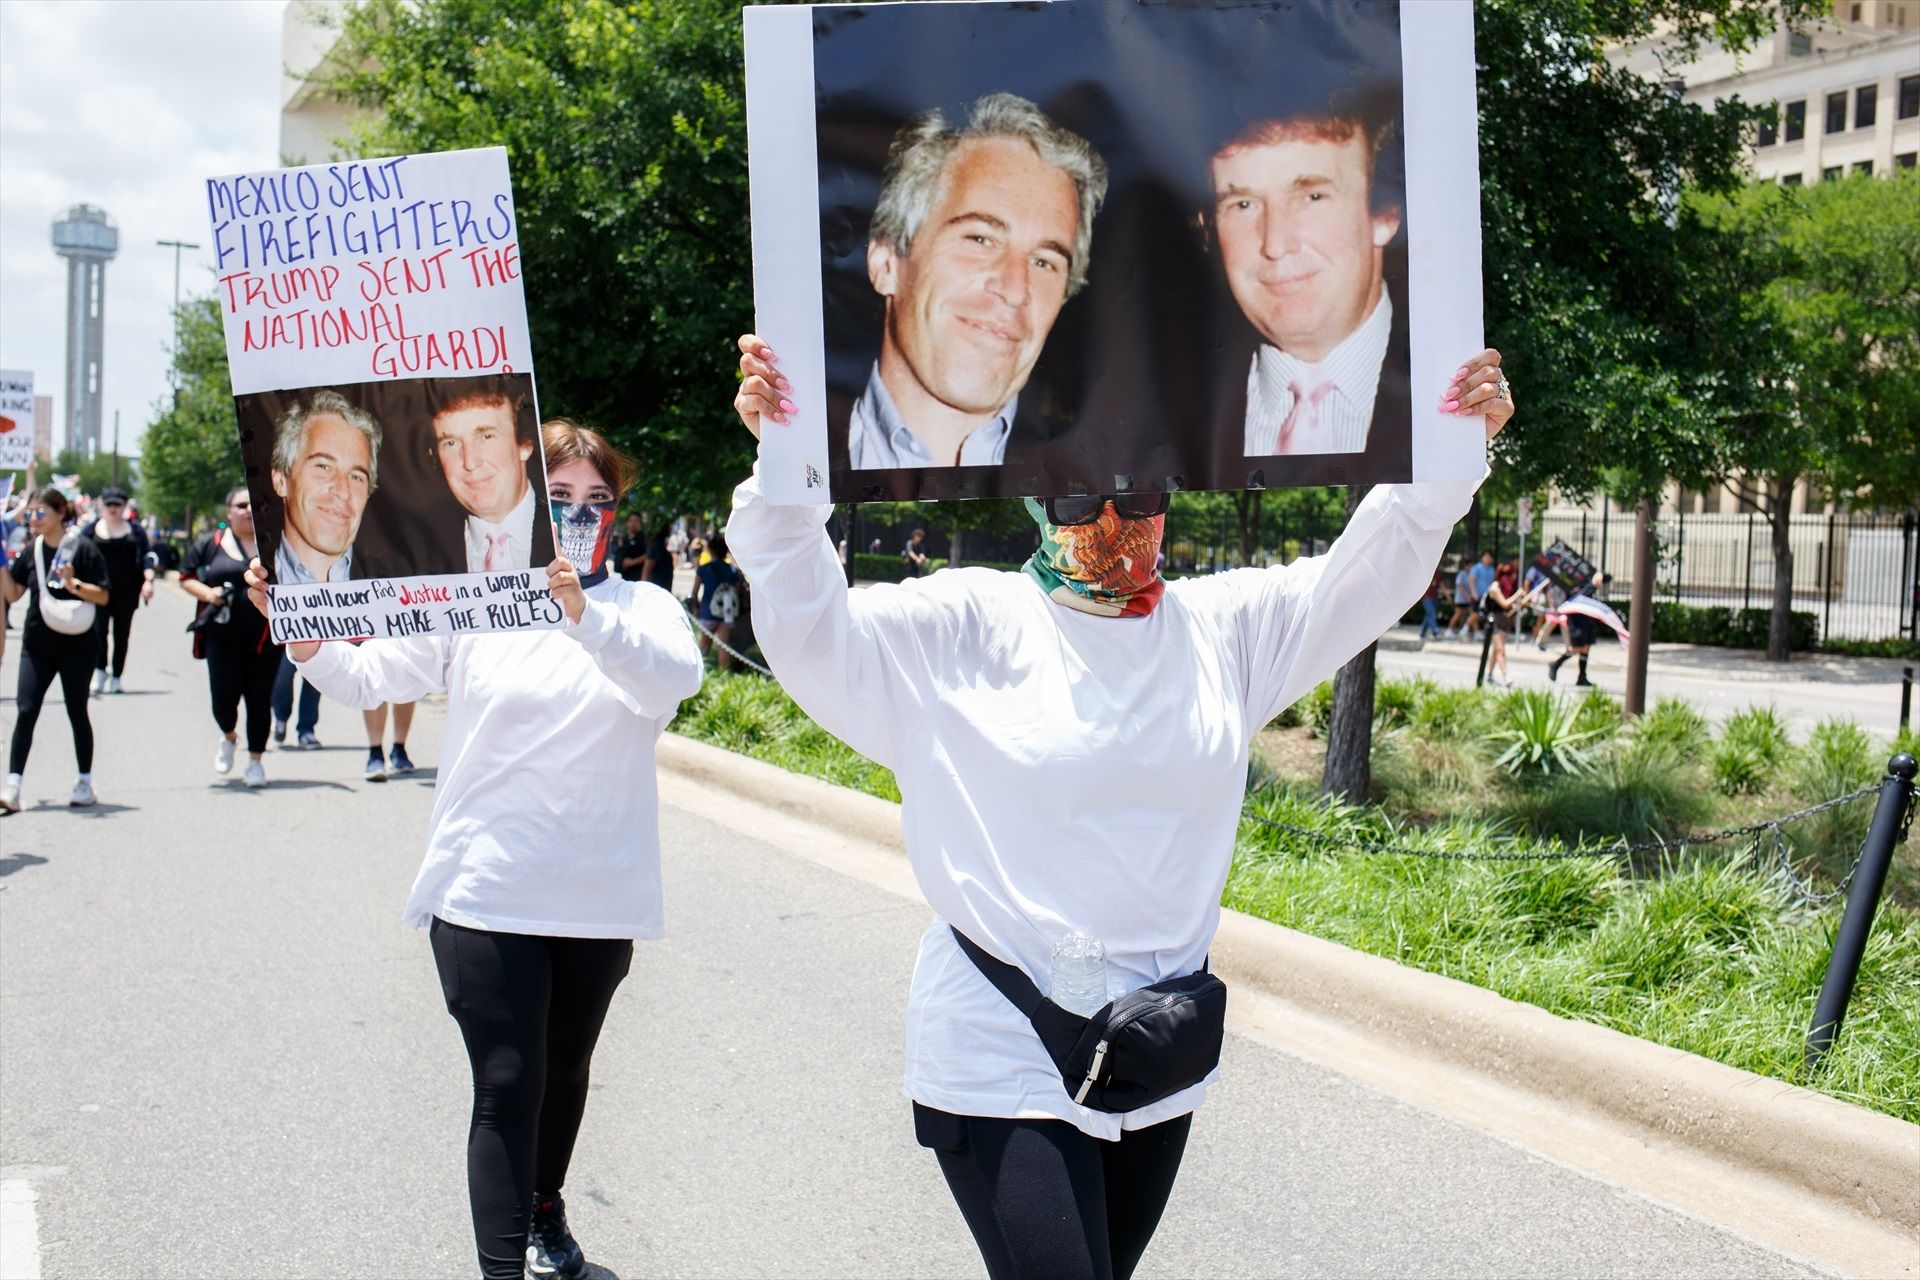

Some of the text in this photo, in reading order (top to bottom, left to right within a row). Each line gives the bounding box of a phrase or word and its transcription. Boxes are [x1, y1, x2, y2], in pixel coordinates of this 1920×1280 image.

[207, 156, 407, 223] MEXICO SENT
[214, 194, 511, 270] FIREFIGHTERS
[219, 244, 520, 313] TRUMP SENT THE
[243, 303, 422, 352] NATIONAL
[372, 326, 513, 378] GUARD!
[272, 597, 563, 642] CRIMINALS MAKE THE RULES
[302, 588, 334, 608] will
[334, 589, 371, 608] never
[399, 583, 451, 606] Justice
[454, 585, 469, 600] in
[472, 586, 483, 598] a
